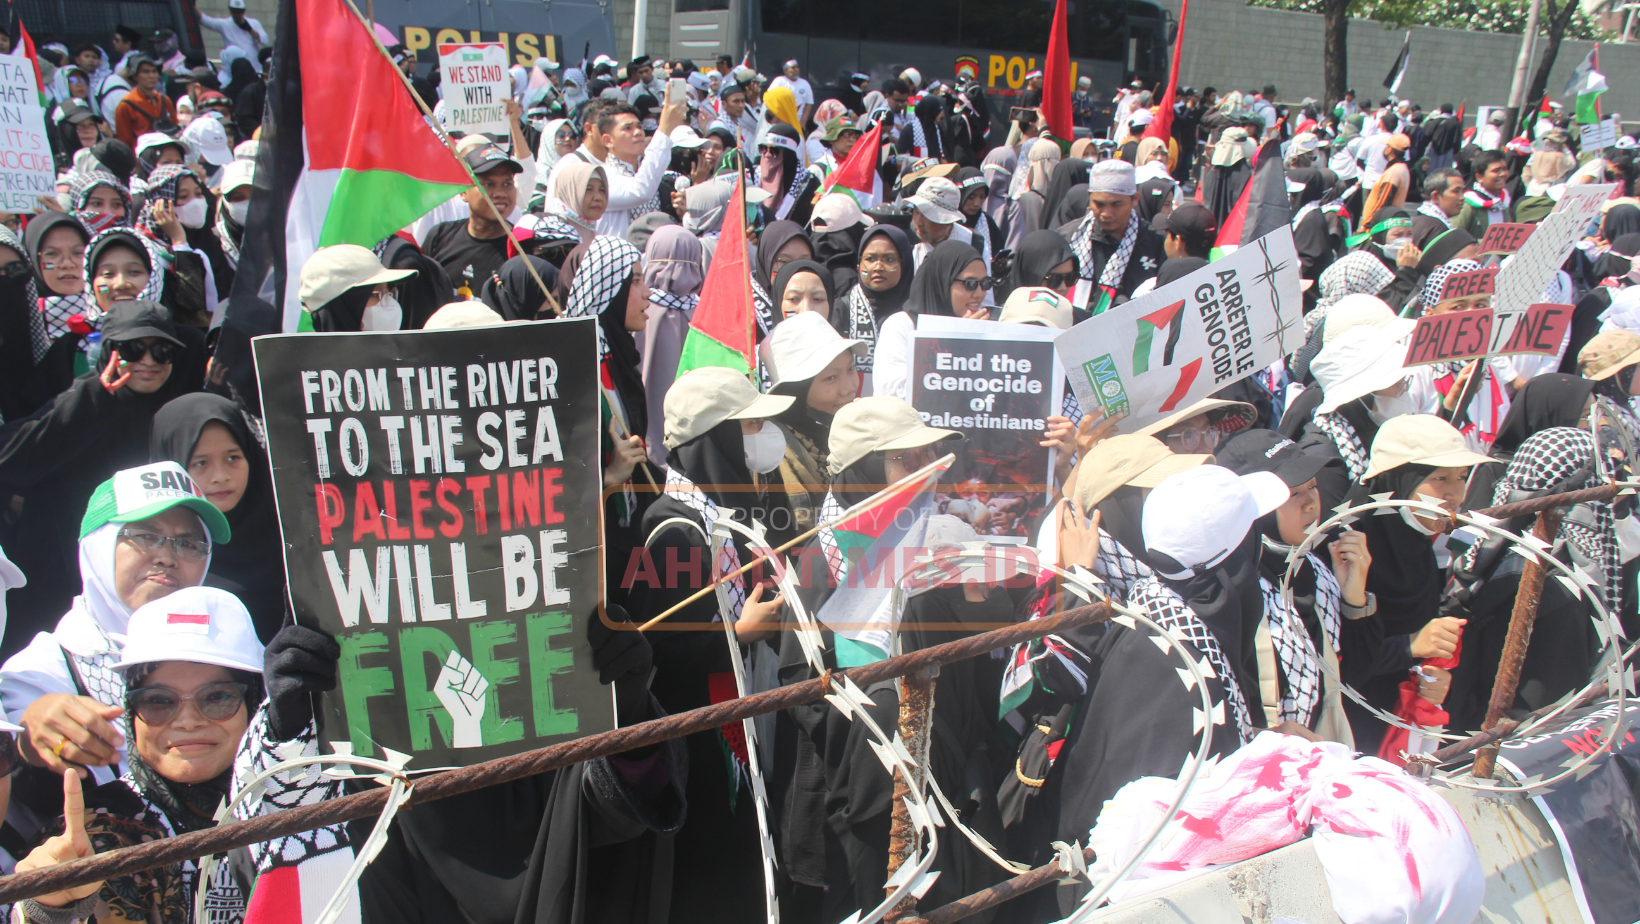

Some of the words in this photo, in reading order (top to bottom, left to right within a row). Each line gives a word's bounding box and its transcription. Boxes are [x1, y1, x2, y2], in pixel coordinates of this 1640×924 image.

[449, 66, 466, 84] WE
[468, 65, 502, 83] STAND
[464, 86, 492, 104] WITH
[453, 106, 503, 126] PALESTINE
[26, 174, 56, 192] NOW
[1482, 226, 1525, 250] FREE
[1444, 273, 1492, 299] FREE
[1215, 268, 1252, 353] ARRÊTER
[1236, 350, 1255, 375] LE
[936, 352, 983, 372] End
[990, 354, 1032, 373] the
[301, 367, 391, 414] FROM
[397, 366, 460, 411] THE
[466, 356, 559, 409] RIVER
[923, 372, 1043, 394] Genocide
[970, 393, 996, 412] of
[919, 411, 1046, 431] Palestinians
[307, 417, 370, 479] TO
[380, 414, 466, 475] THE
[477, 405, 564, 471] SEA
[314, 467, 566, 545] PALESTINE
[321, 541, 487, 628] WILL
[500, 529, 572, 613] BE
[334, 611, 579, 757] FREE
